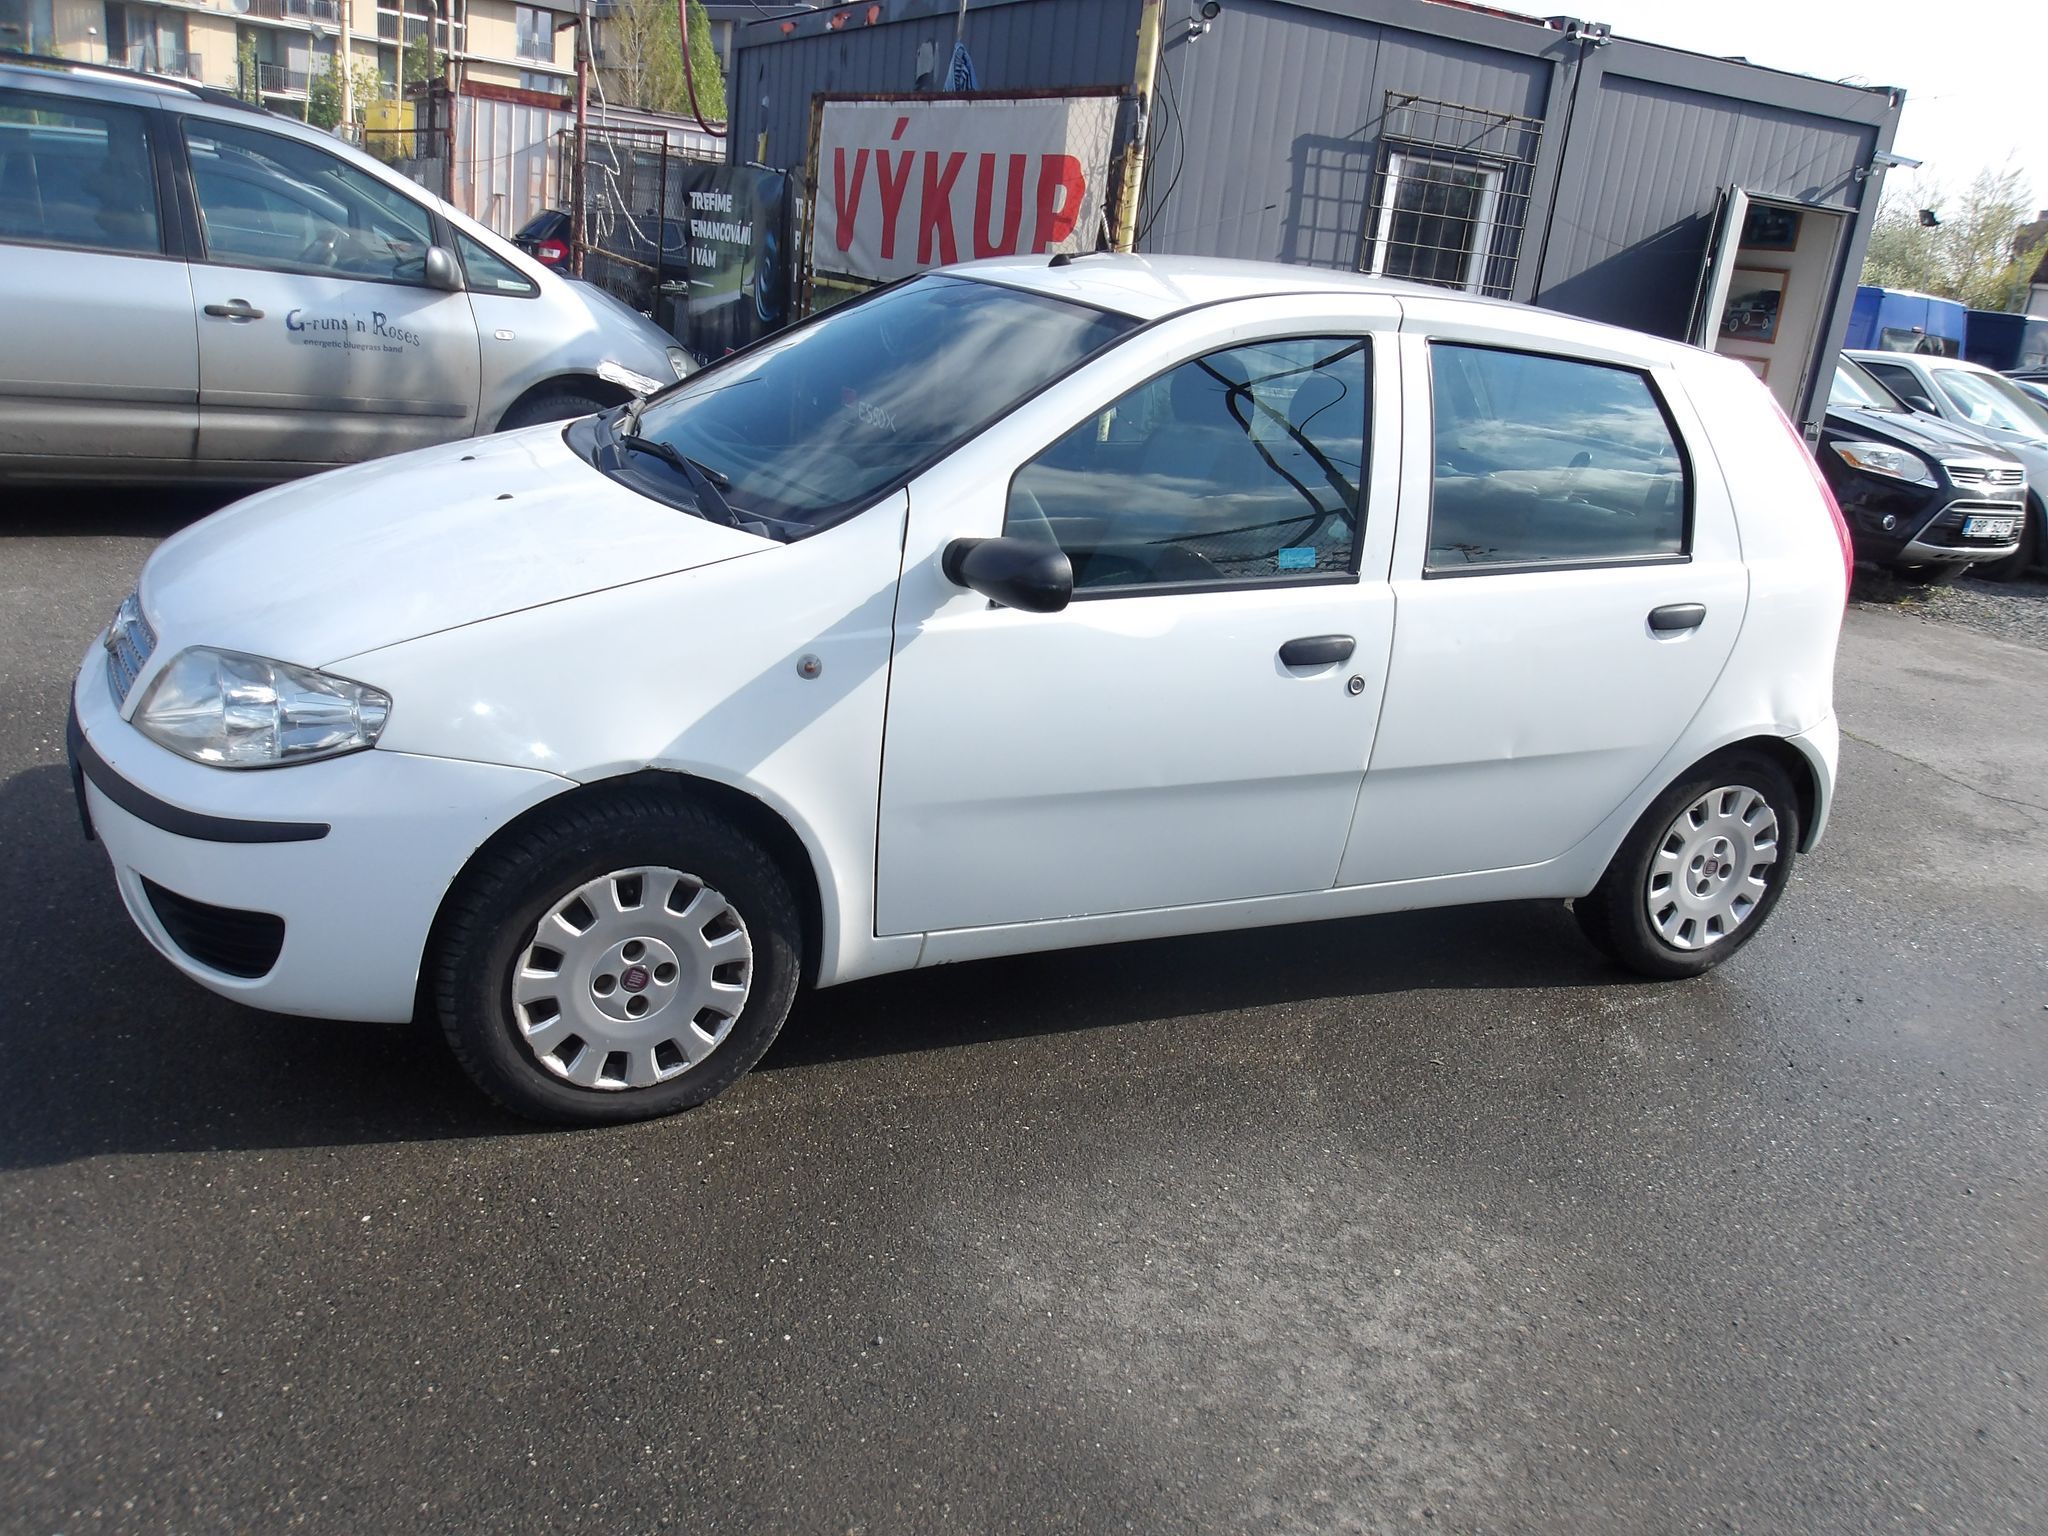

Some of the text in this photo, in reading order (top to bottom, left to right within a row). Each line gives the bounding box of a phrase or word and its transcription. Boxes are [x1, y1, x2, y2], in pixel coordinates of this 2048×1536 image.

[689, 188, 732, 213] TREFÍME
[834, 117, 1085, 265] VÝKUP
[690, 219, 753, 246] FINANCOVÁNÍ
[691, 244, 717, 268] I VÁM
[372, 311, 420, 347] Roses
[303, 338, 403, 354] energetic bluegrass band
